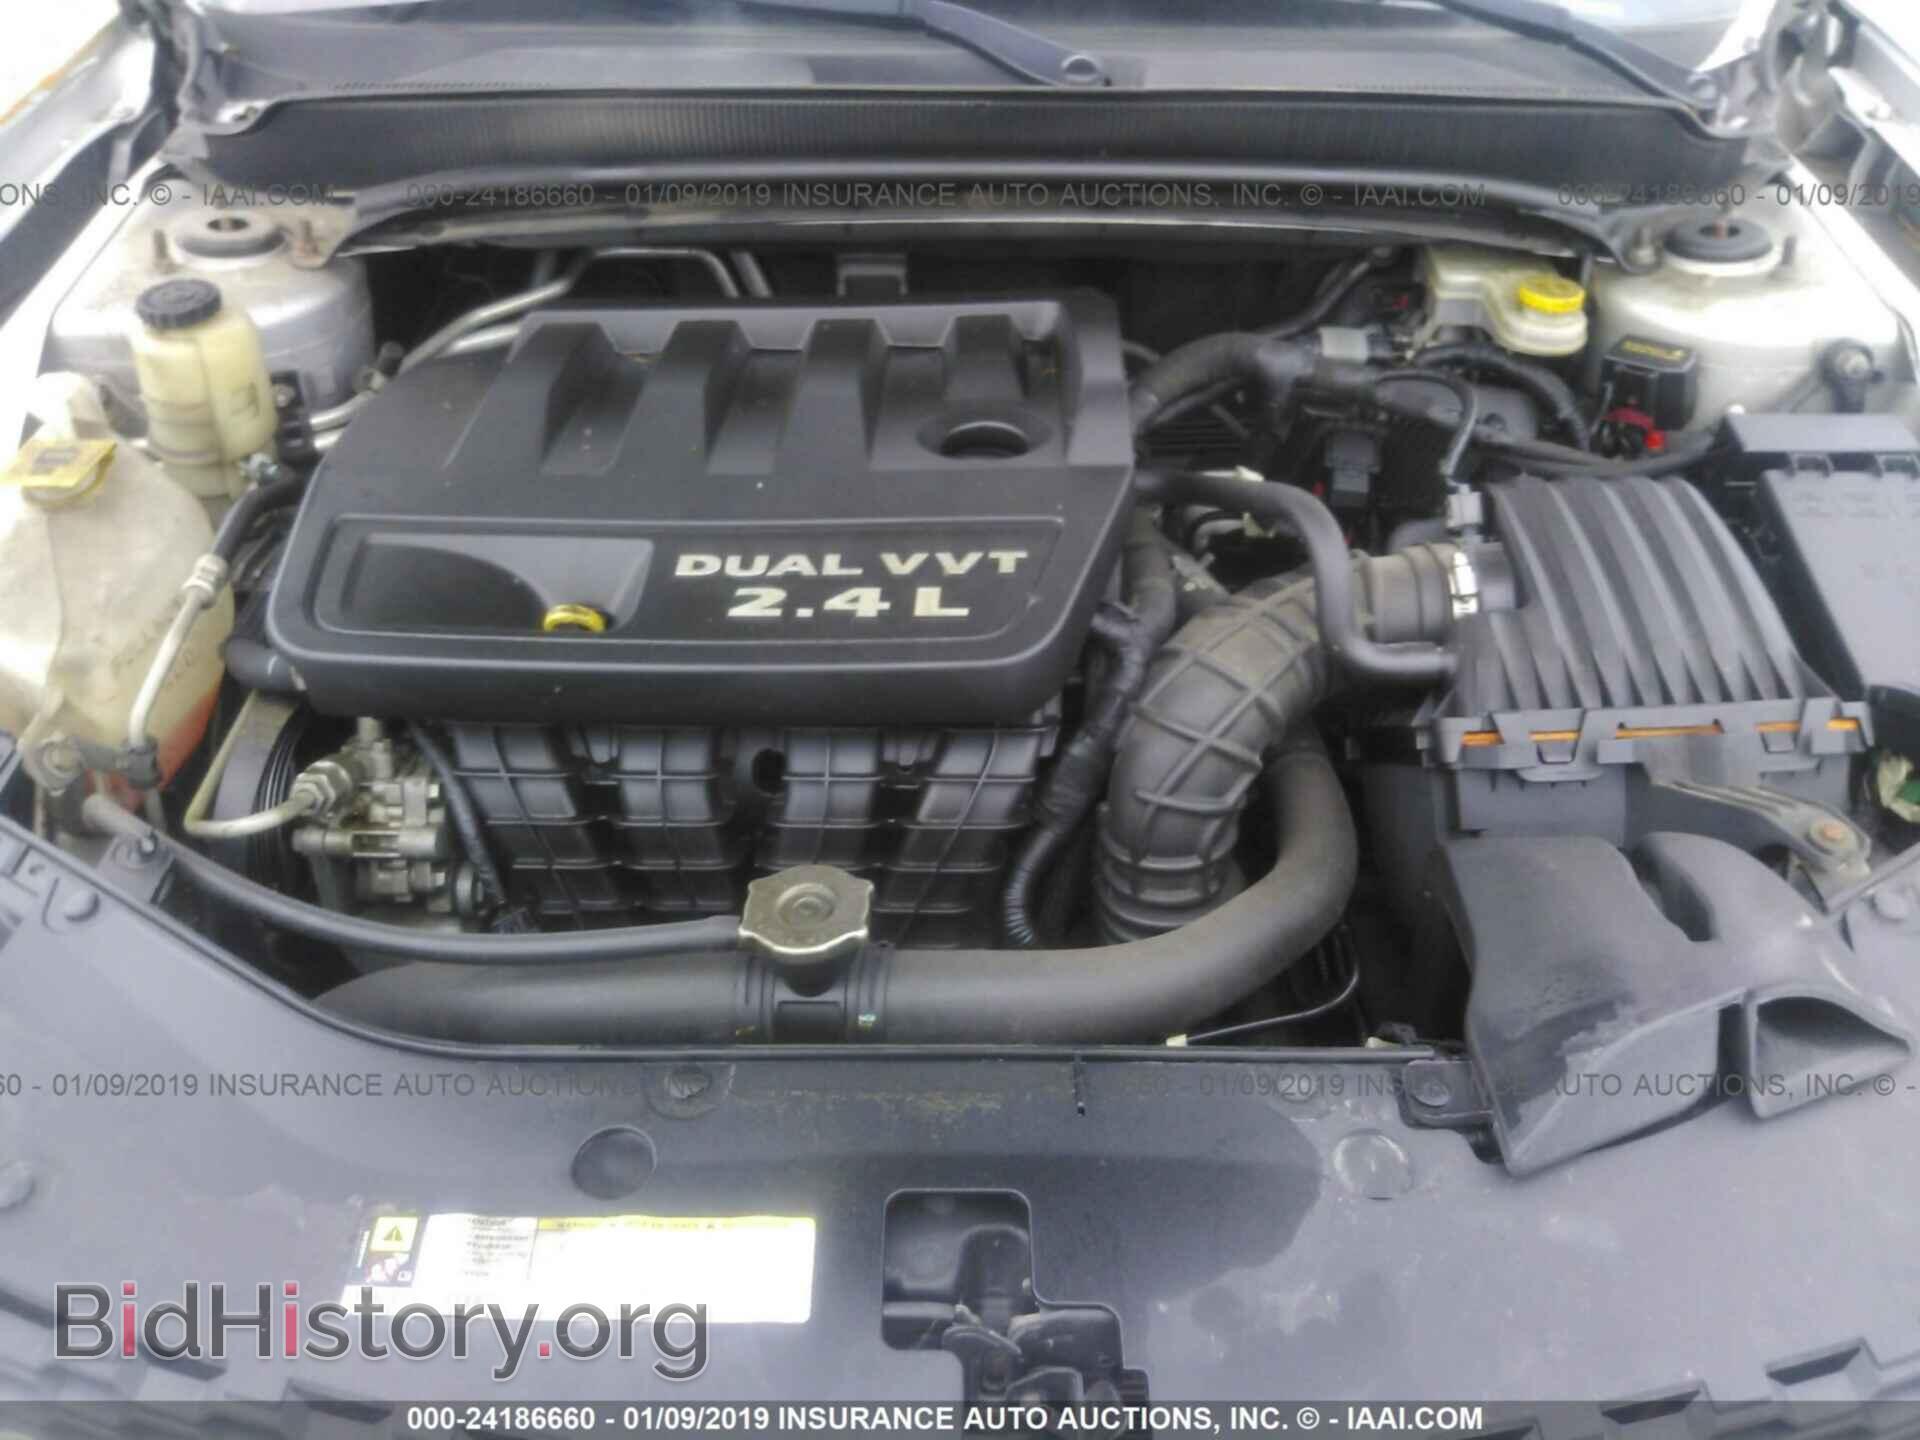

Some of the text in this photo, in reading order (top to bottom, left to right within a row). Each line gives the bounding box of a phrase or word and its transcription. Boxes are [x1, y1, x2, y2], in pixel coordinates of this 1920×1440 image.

[675, 550, 1028, 576] DUAL VVT
[727, 587, 970, 617] 2.4 L
